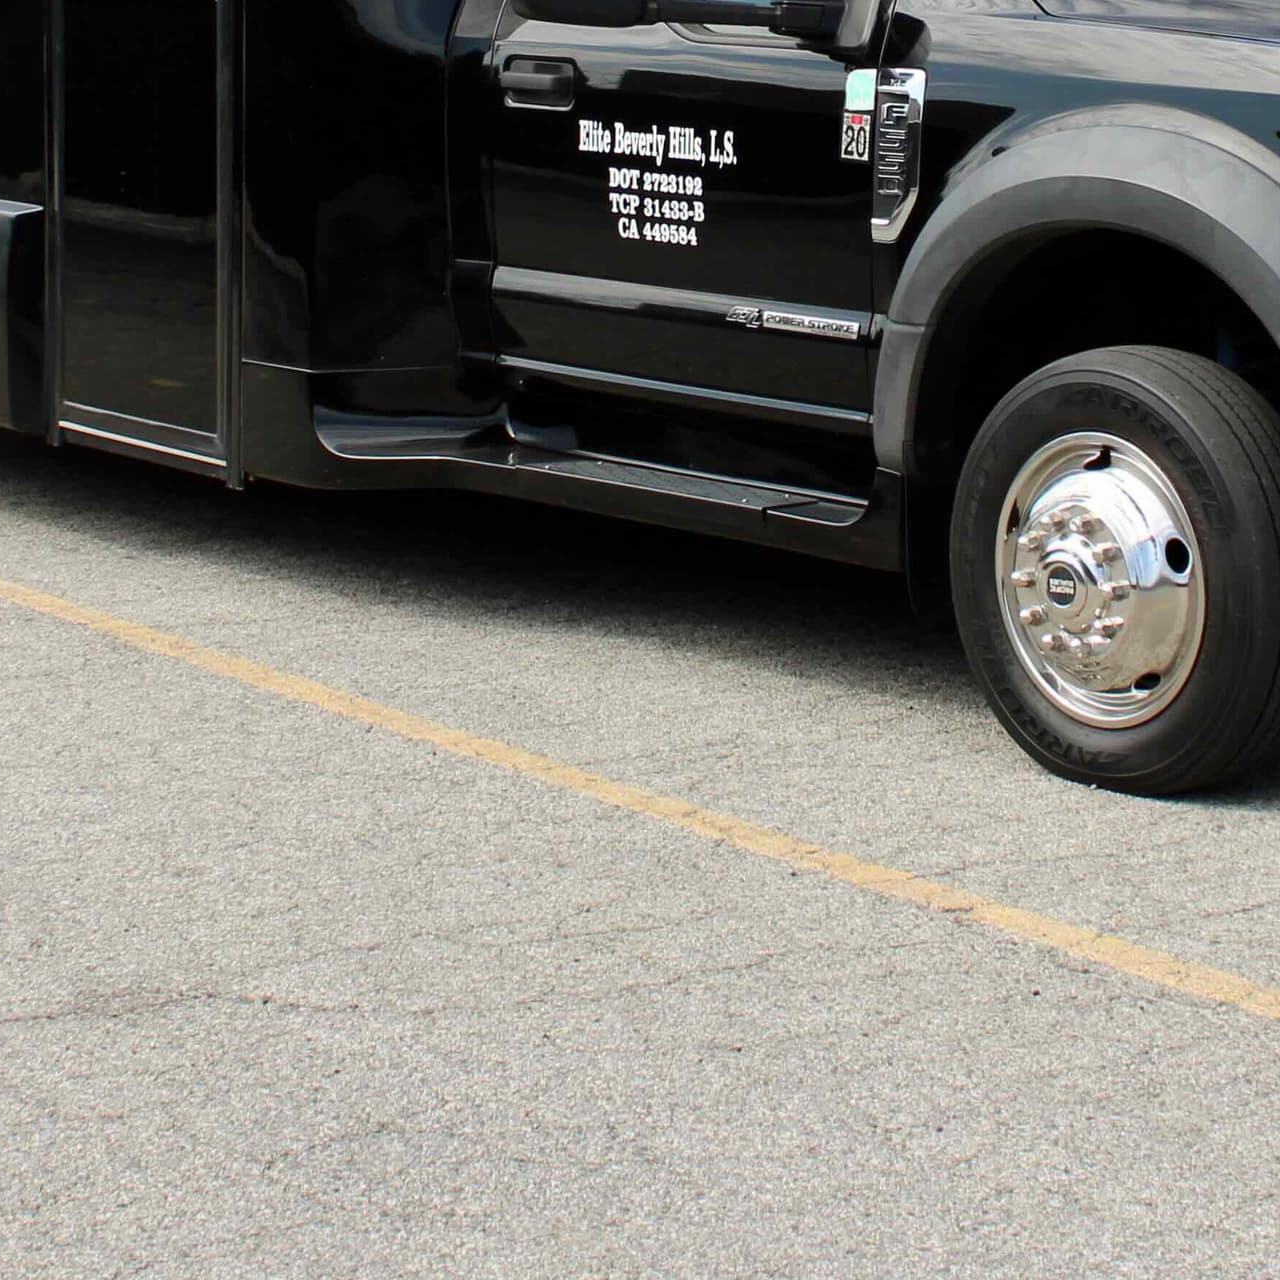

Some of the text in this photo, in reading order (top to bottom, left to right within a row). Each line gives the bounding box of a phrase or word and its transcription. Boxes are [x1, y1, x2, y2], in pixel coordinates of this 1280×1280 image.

[578, 119, 612, 153] Elite
[614, 122, 665, 167] Beverly
[668, 126, 706, 167] Hills,
[844, 125, 867, 158] 20
[608, 167, 703, 196] DOT 2723192
[609, 193, 705, 222] TCP 31433-B
[618, 218, 698, 246] CA 449584
[765, 314, 806, 328] POWER
[808, 320, 858, 334] STROKE
